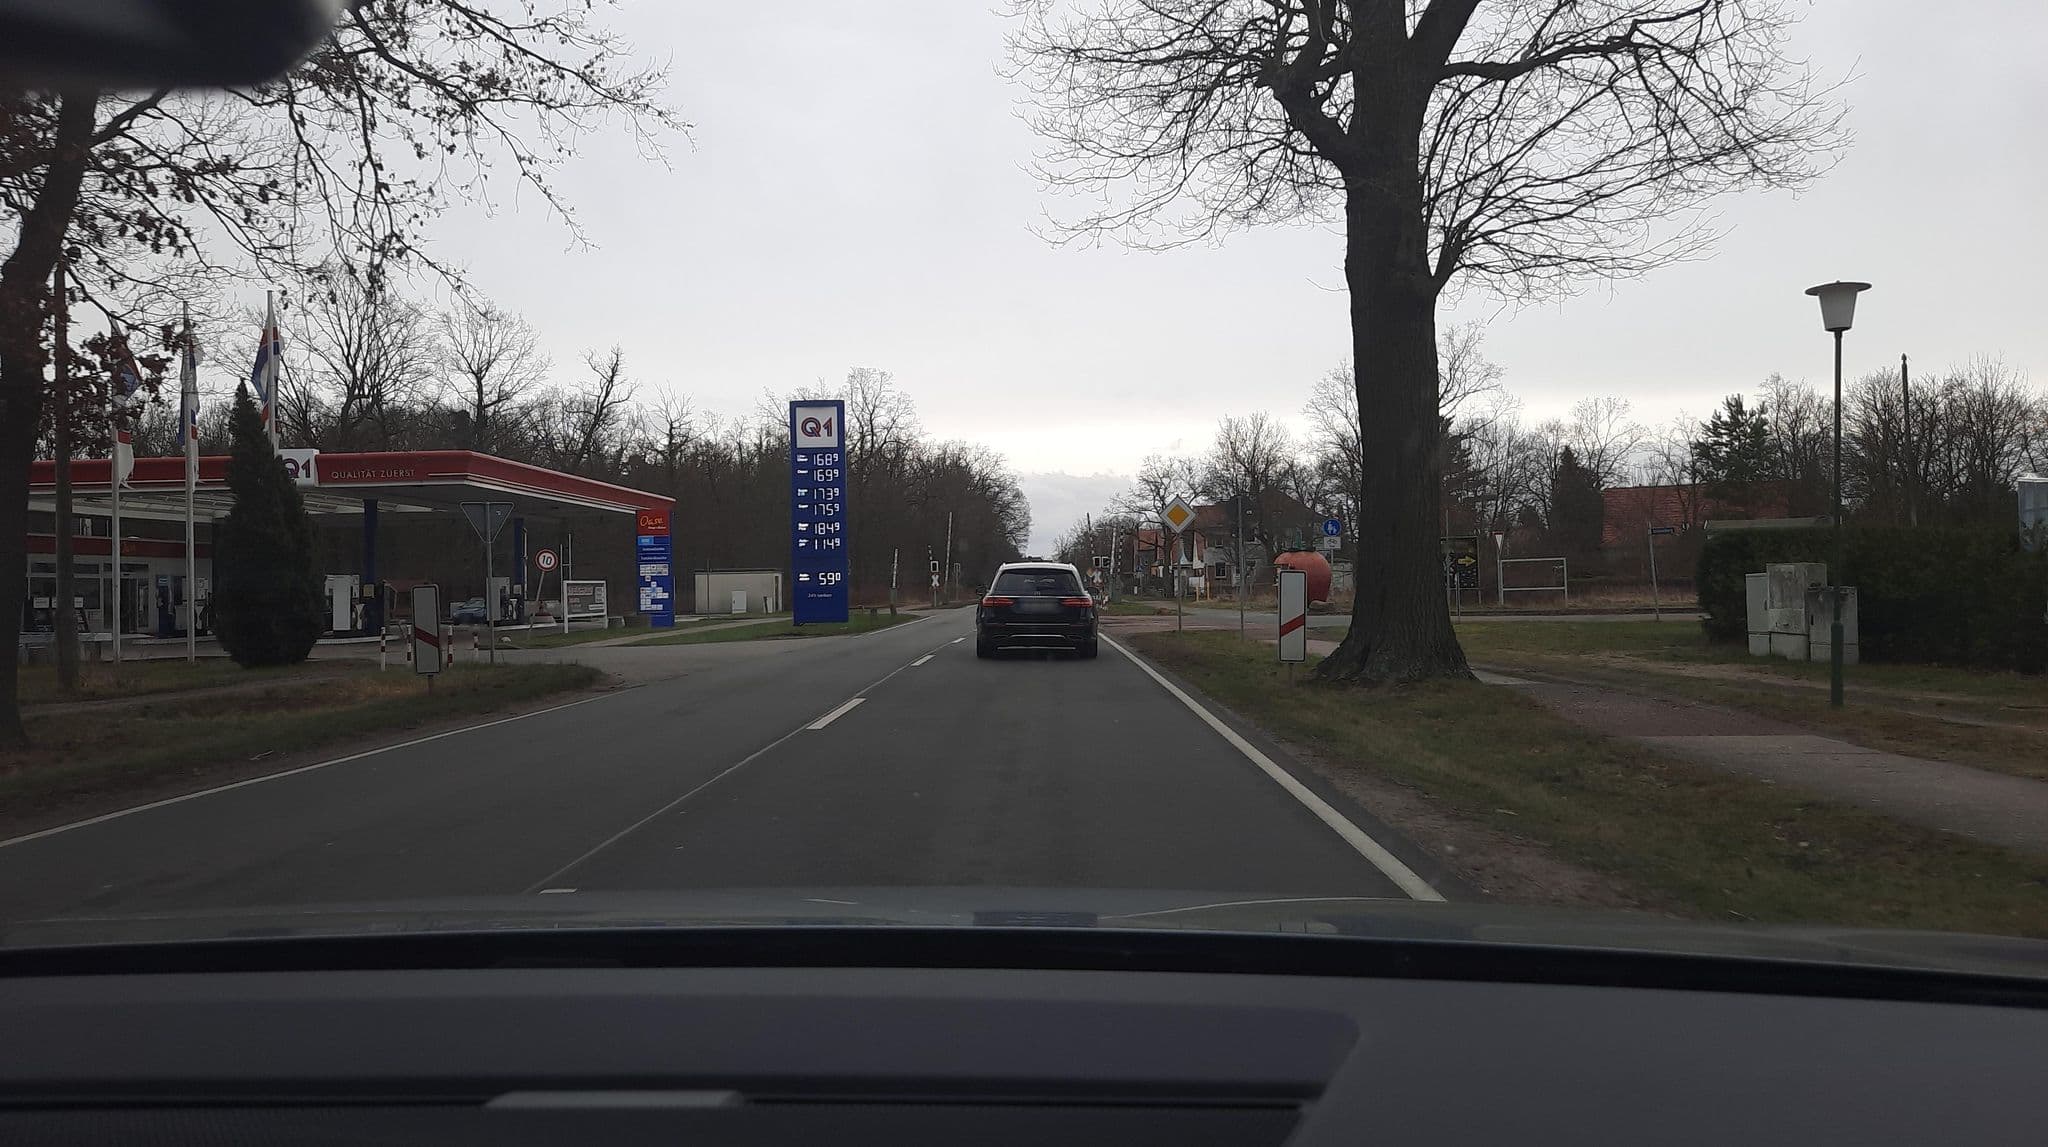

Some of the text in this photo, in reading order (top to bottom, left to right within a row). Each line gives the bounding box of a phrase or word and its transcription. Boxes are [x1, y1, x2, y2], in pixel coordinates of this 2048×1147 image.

[801, 417, 833, 438] Q1
[331, 469, 415, 480] QUALITÄT ZUERST
[542, 555, 553, 566] 10
